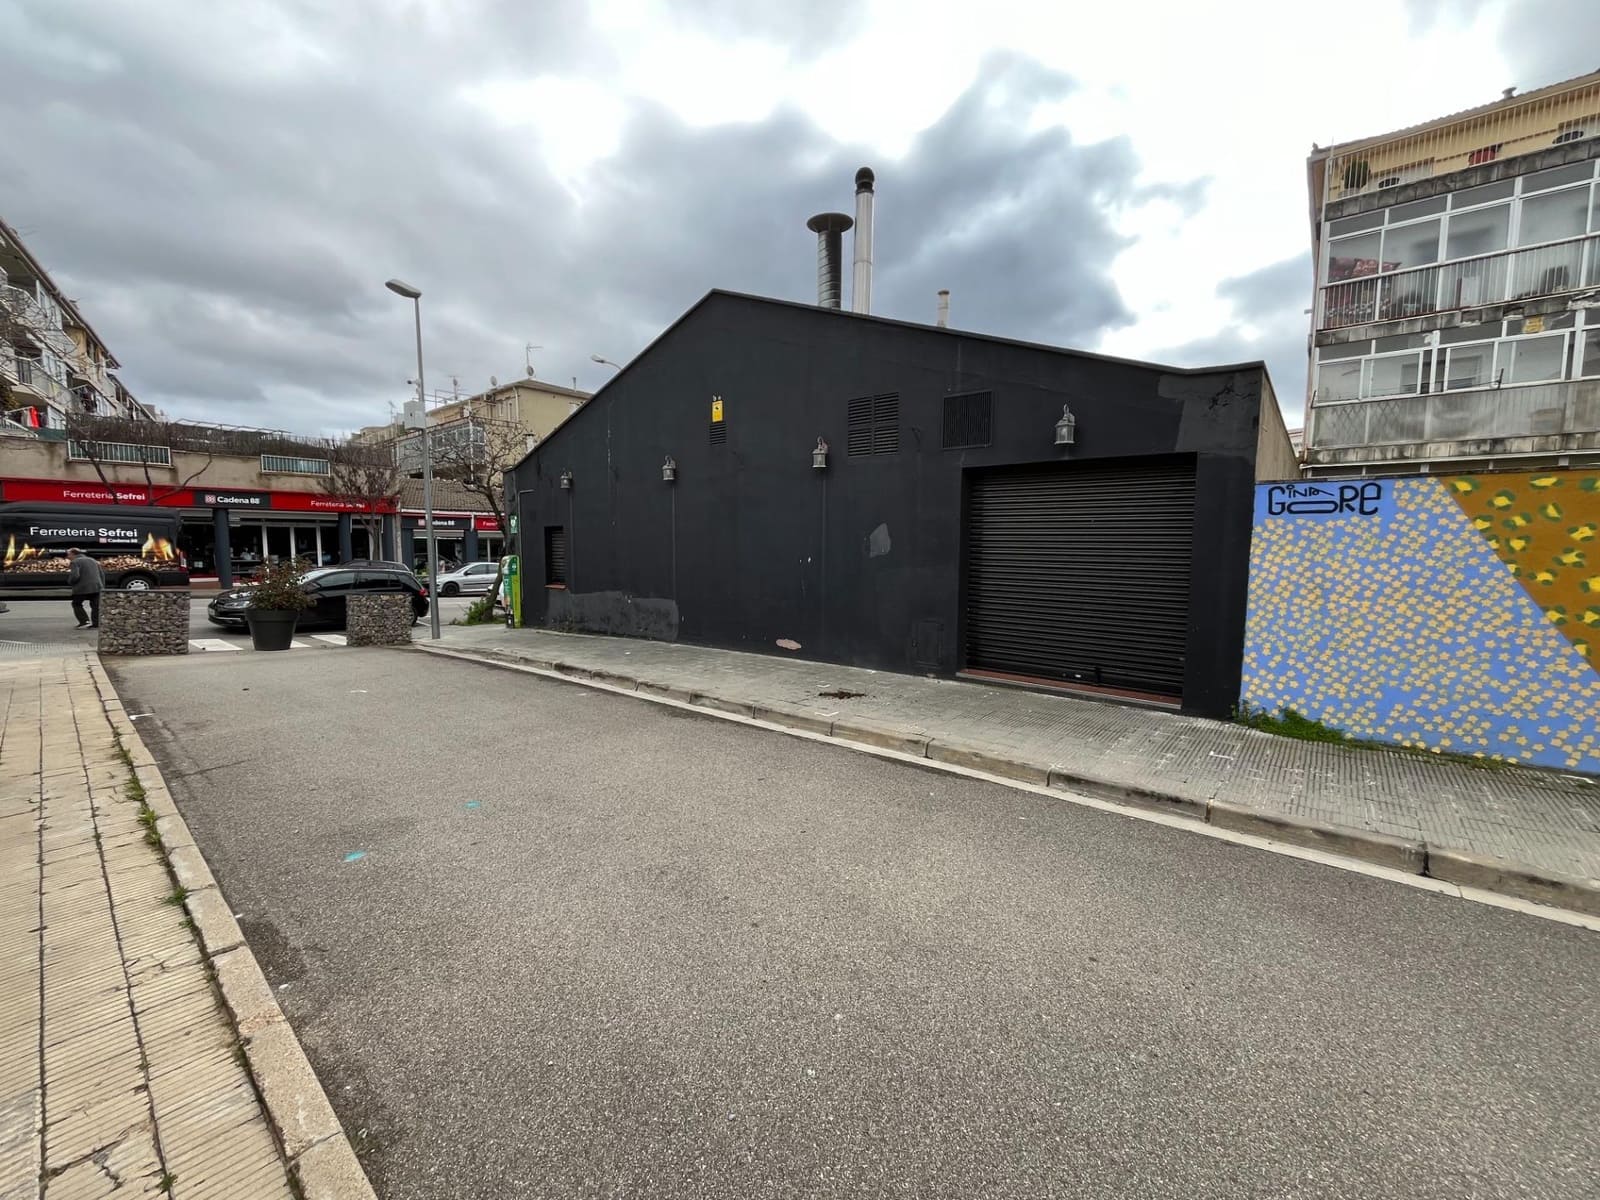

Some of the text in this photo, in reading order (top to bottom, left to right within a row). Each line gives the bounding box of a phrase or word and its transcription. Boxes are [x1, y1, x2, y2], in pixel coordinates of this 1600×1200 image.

[63, 490, 145, 500] Ferreteria Sefrei
[217, 496, 260, 505] Cadena 88
[30, 526, 138, 537] Ferreteria Sefrei
